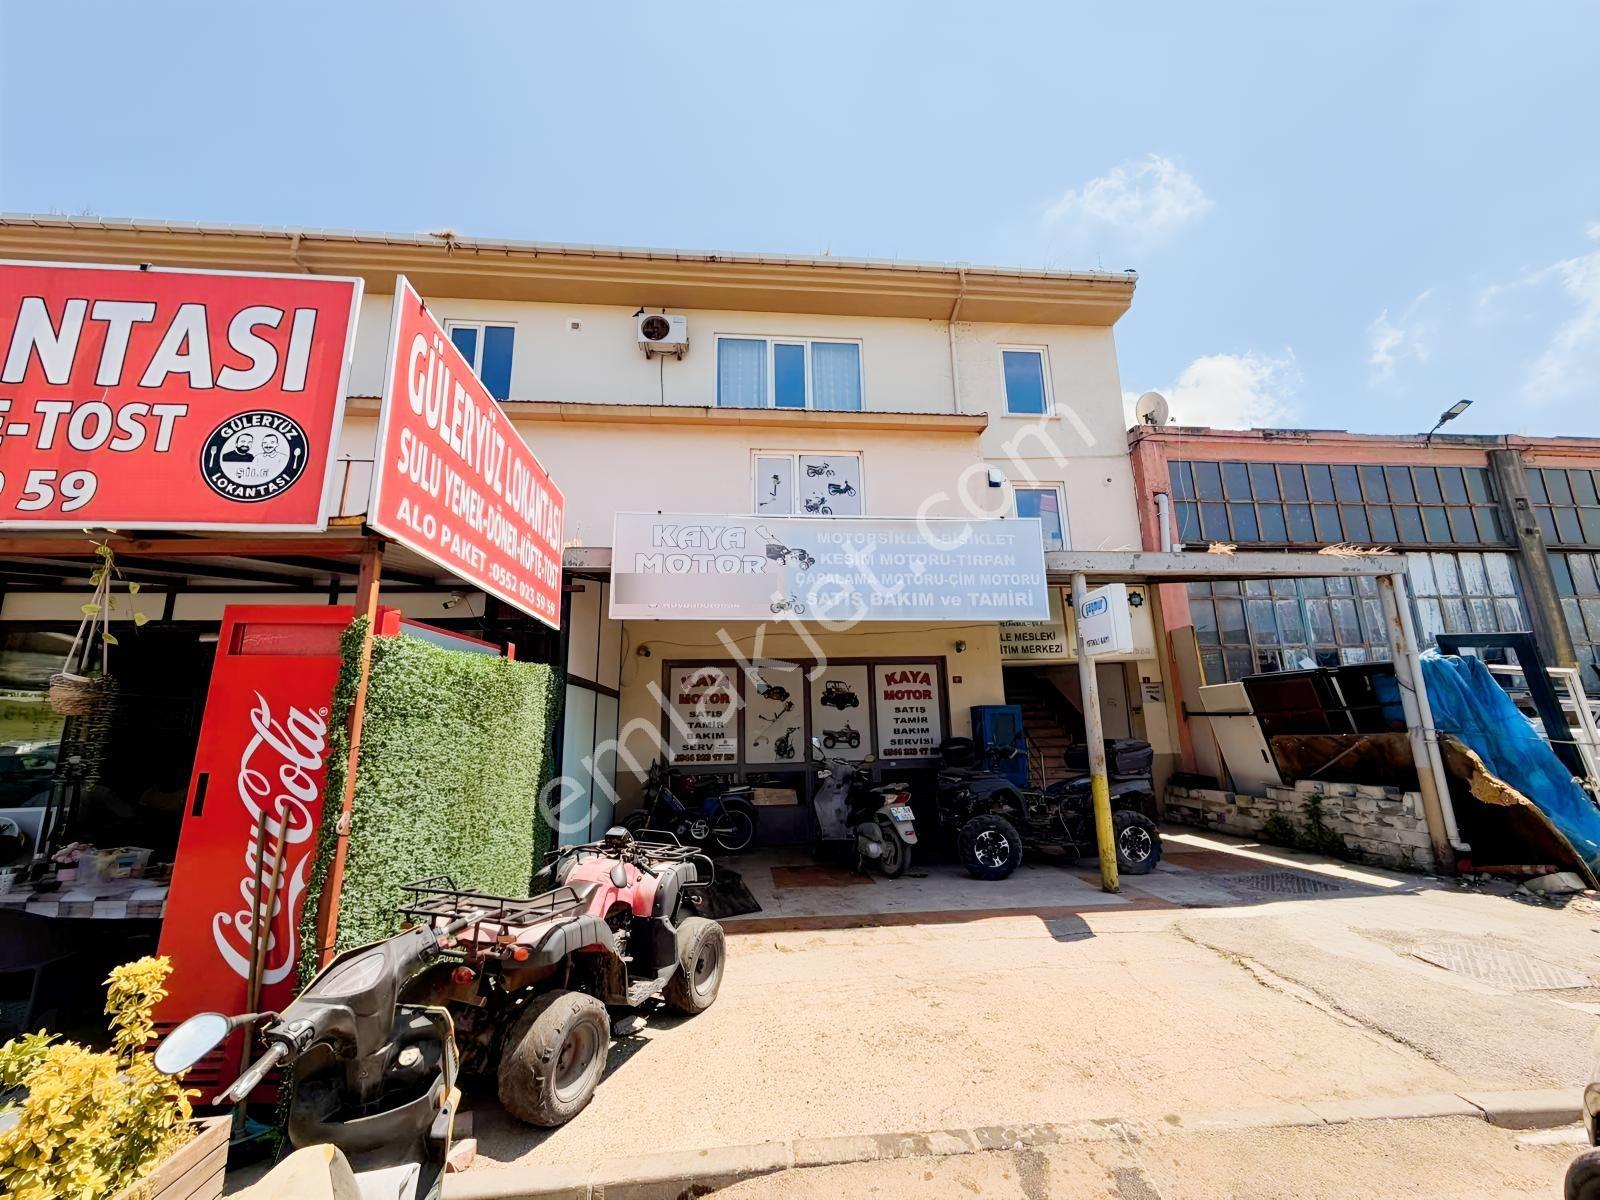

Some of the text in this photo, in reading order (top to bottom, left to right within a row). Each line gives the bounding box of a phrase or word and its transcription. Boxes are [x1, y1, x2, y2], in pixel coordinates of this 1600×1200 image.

[1, 296, 318, 392] NTASI
[220, 415, 298, 440] GÜLERYÜZ
[408, 332, 561, 554] GÜLERYÜZ LOKANTASI
[397, 427, 442, 498] SULU
[15, 469, 98, 512] 59
[212, 473, 291, 497] LOKANTASI
[652, 524, 747, 550] KAYA
[396, 497, 437, 540] ALO
[440, 523, 487, 572] PAKET
[519, 581, 534, 605] 023
[536, 592, 546, 610] 59
[880, 553, 1016, 567] MOTORU-TIRPAN
[635, 553, 767, 575] MOTOR
[887, 571, 975, 588] MOTORU-ÇİM
[979, 573, 1041, 586] MOTORU
[870, 592, 934, 608] BAKIM
[941, 595, 961, 607] ve
[967, 589, 1033, 608] TAMİRİ
[1015, 631, 1056, 641] MESLEKİ
[1021, 643, 1063, 654] MERKEZİ
[681, 674, 730, 689] KAYA
[884, 670, 932, 686] KAYA
[678, 693, 730, 704] MOTOR
[883, 689, 933, 700] MOTOR
[893, 716, 928, 724] TAMİR
[893, 727, 930, 735] BAKIM
